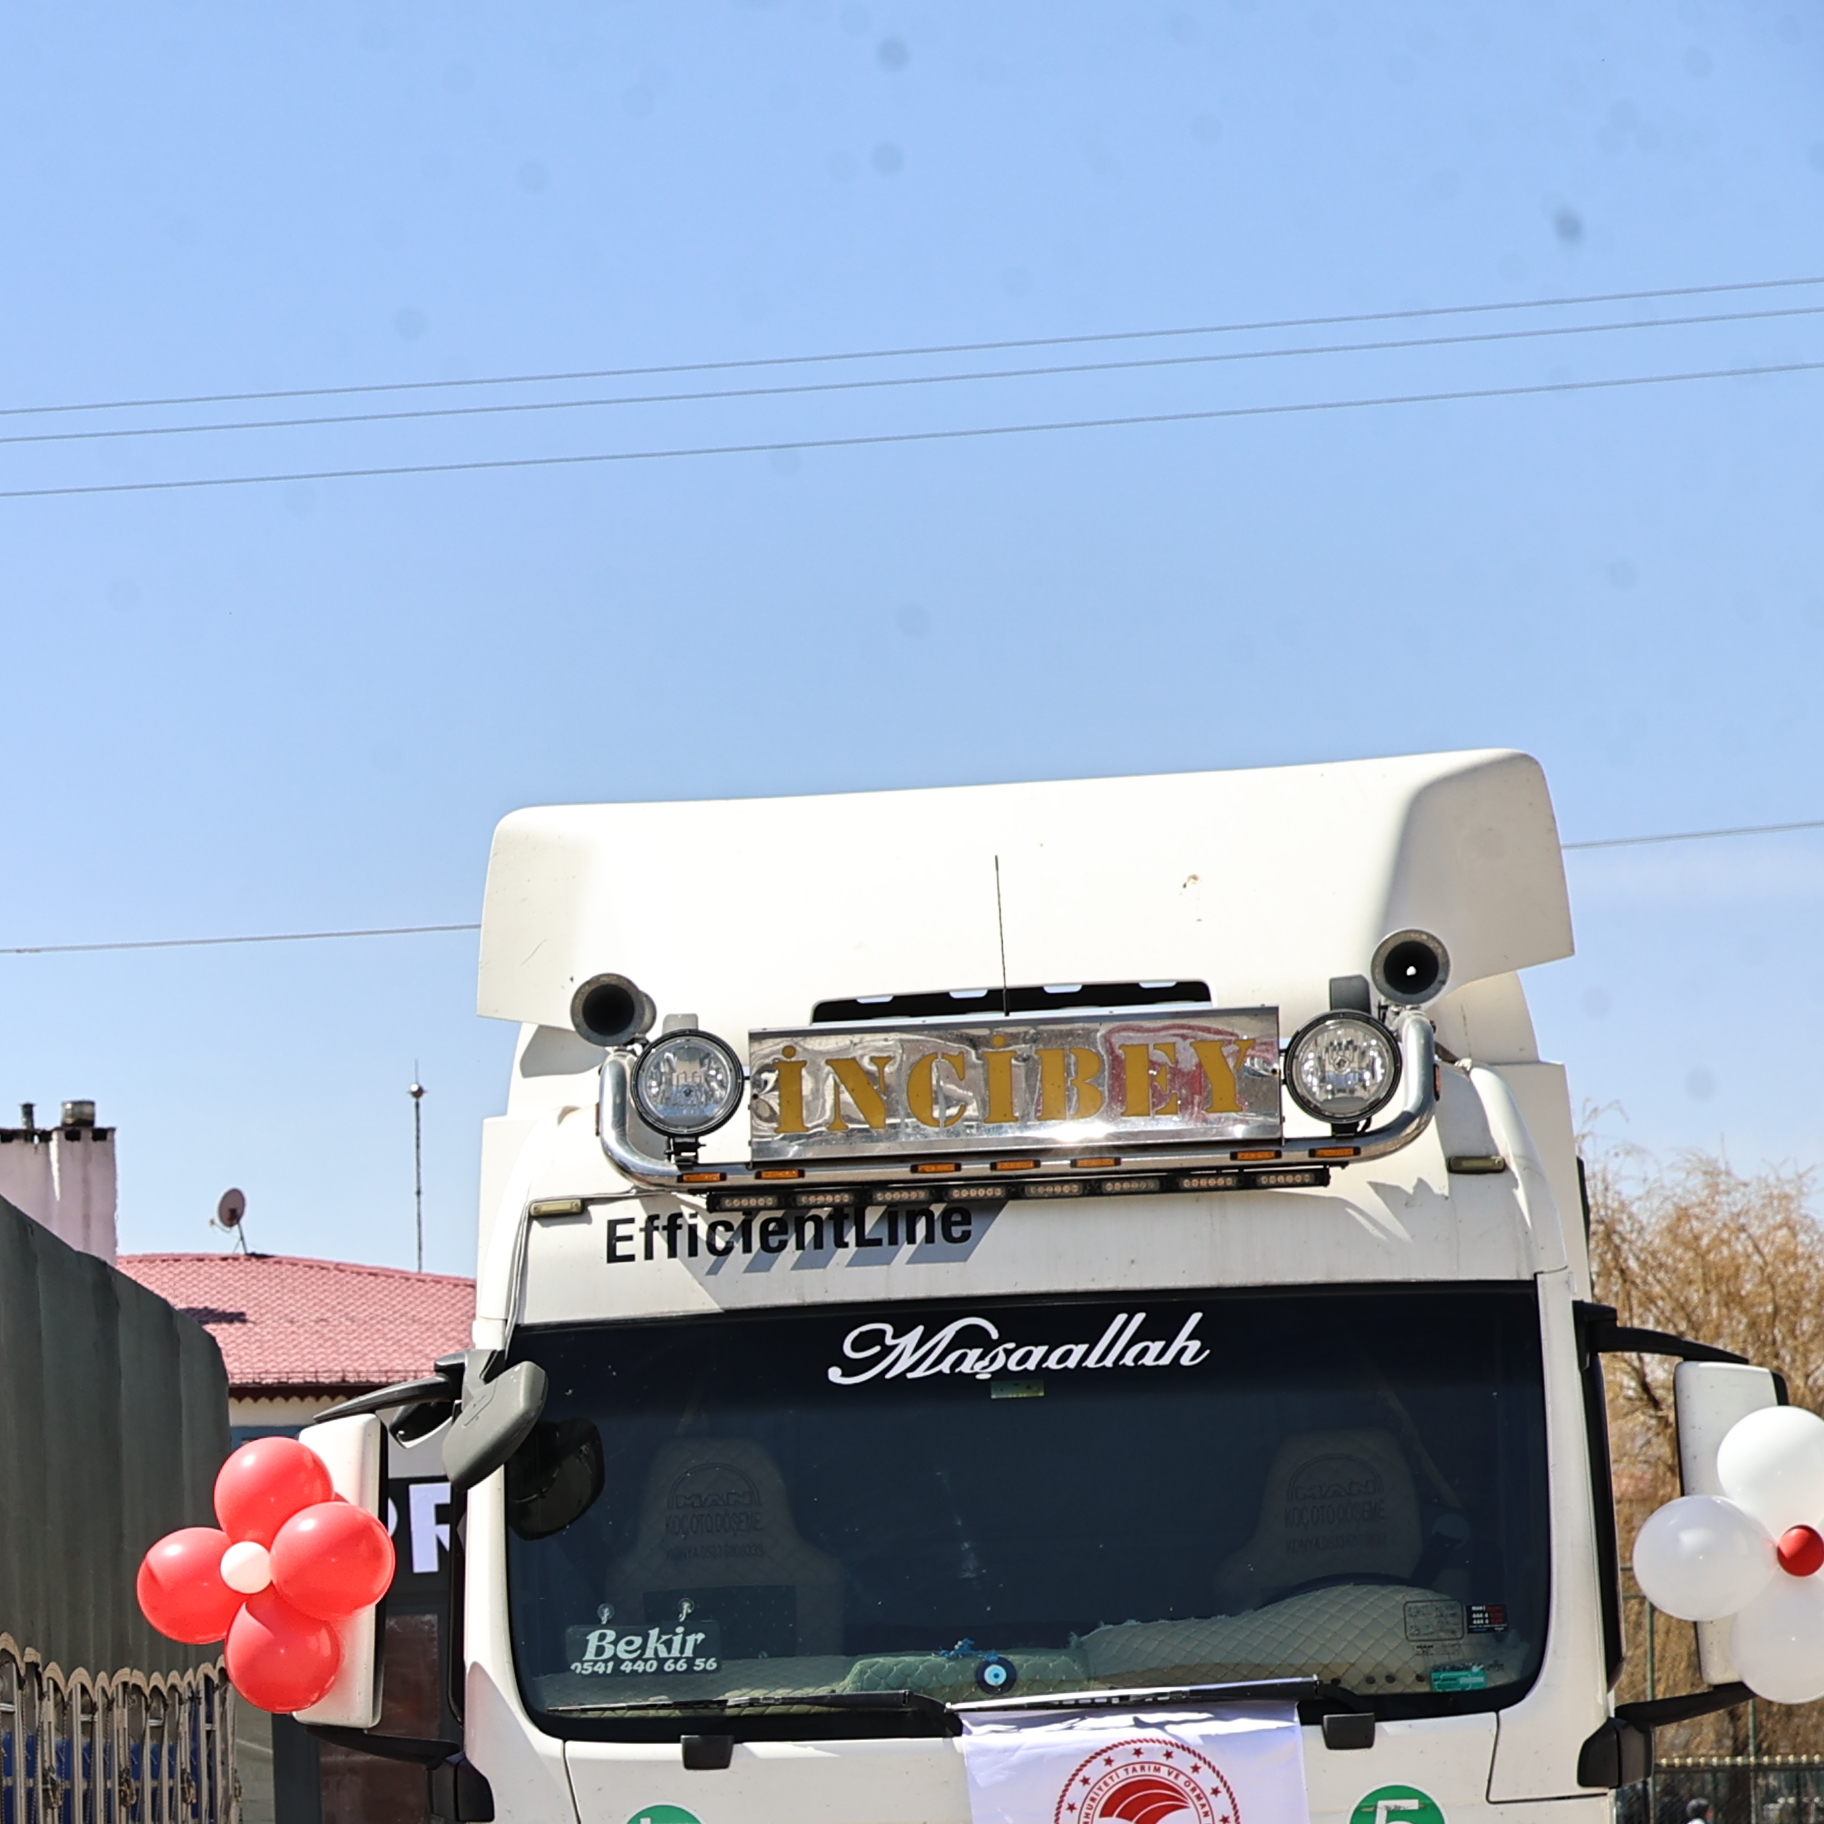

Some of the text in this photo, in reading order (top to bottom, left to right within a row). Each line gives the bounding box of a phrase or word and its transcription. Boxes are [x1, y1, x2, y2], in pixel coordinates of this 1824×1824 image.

[606, 1203, 973, 1264] EfficientLine
[675, 1491, 754, 1509] MAN
[582, 1626, 706, 1661] Bekir
[620, 1660, 658, 1674] 440
[663, 1659, 688, 1672] 66
[693, 1658, 718, 1671] 56
[1123, 1764, 1161, 1776] TARIM
[1167, 1768, 1180, 1781] VE
[1183, 1780, 1210, 1817] ORMAN
